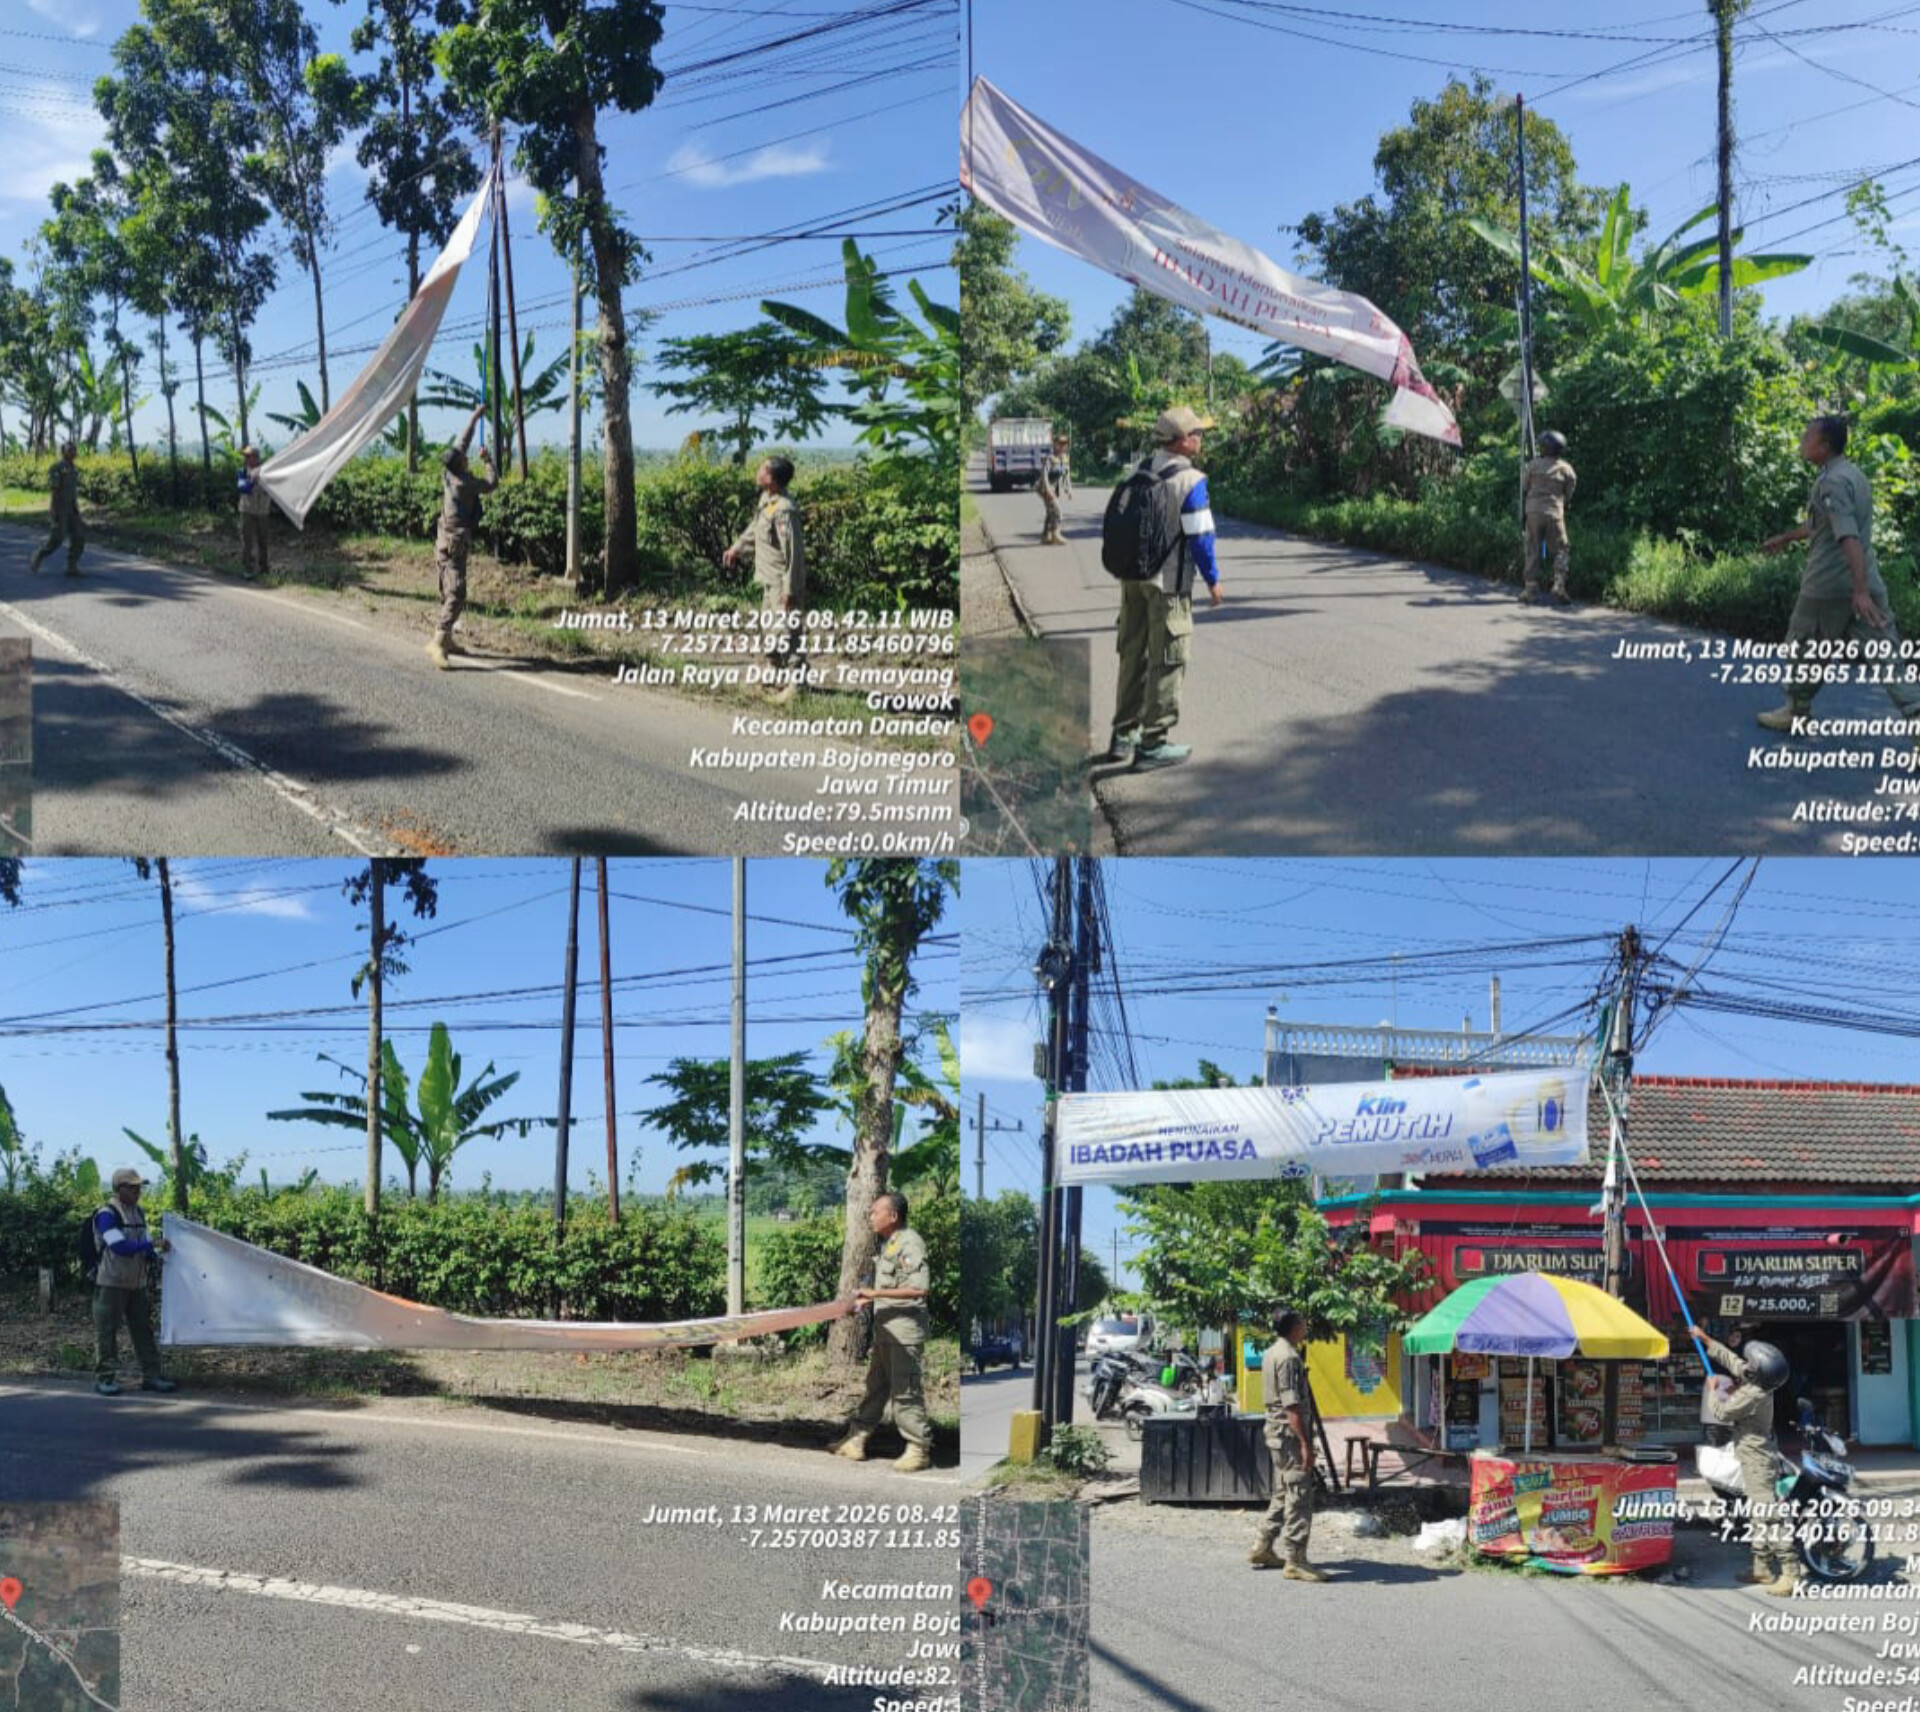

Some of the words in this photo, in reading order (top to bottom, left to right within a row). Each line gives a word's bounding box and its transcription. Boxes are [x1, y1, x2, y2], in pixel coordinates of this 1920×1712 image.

[1355, 1097, 1408, 1117] Klin
[1310, 1113, 1453, 1147] PEMUTIH
[1070, 1142, 1163, 1165] IBADAH
[1169, 1139, 1259, 1162] PUASA
[1493, 1253, 1567, 1272] DJARUM
[1570, 1252, 1607, 1270] SUP
[1735, 1255, 1801, 1273] DJARUM
[1805, 1255, 1859, 1271] SUPER
